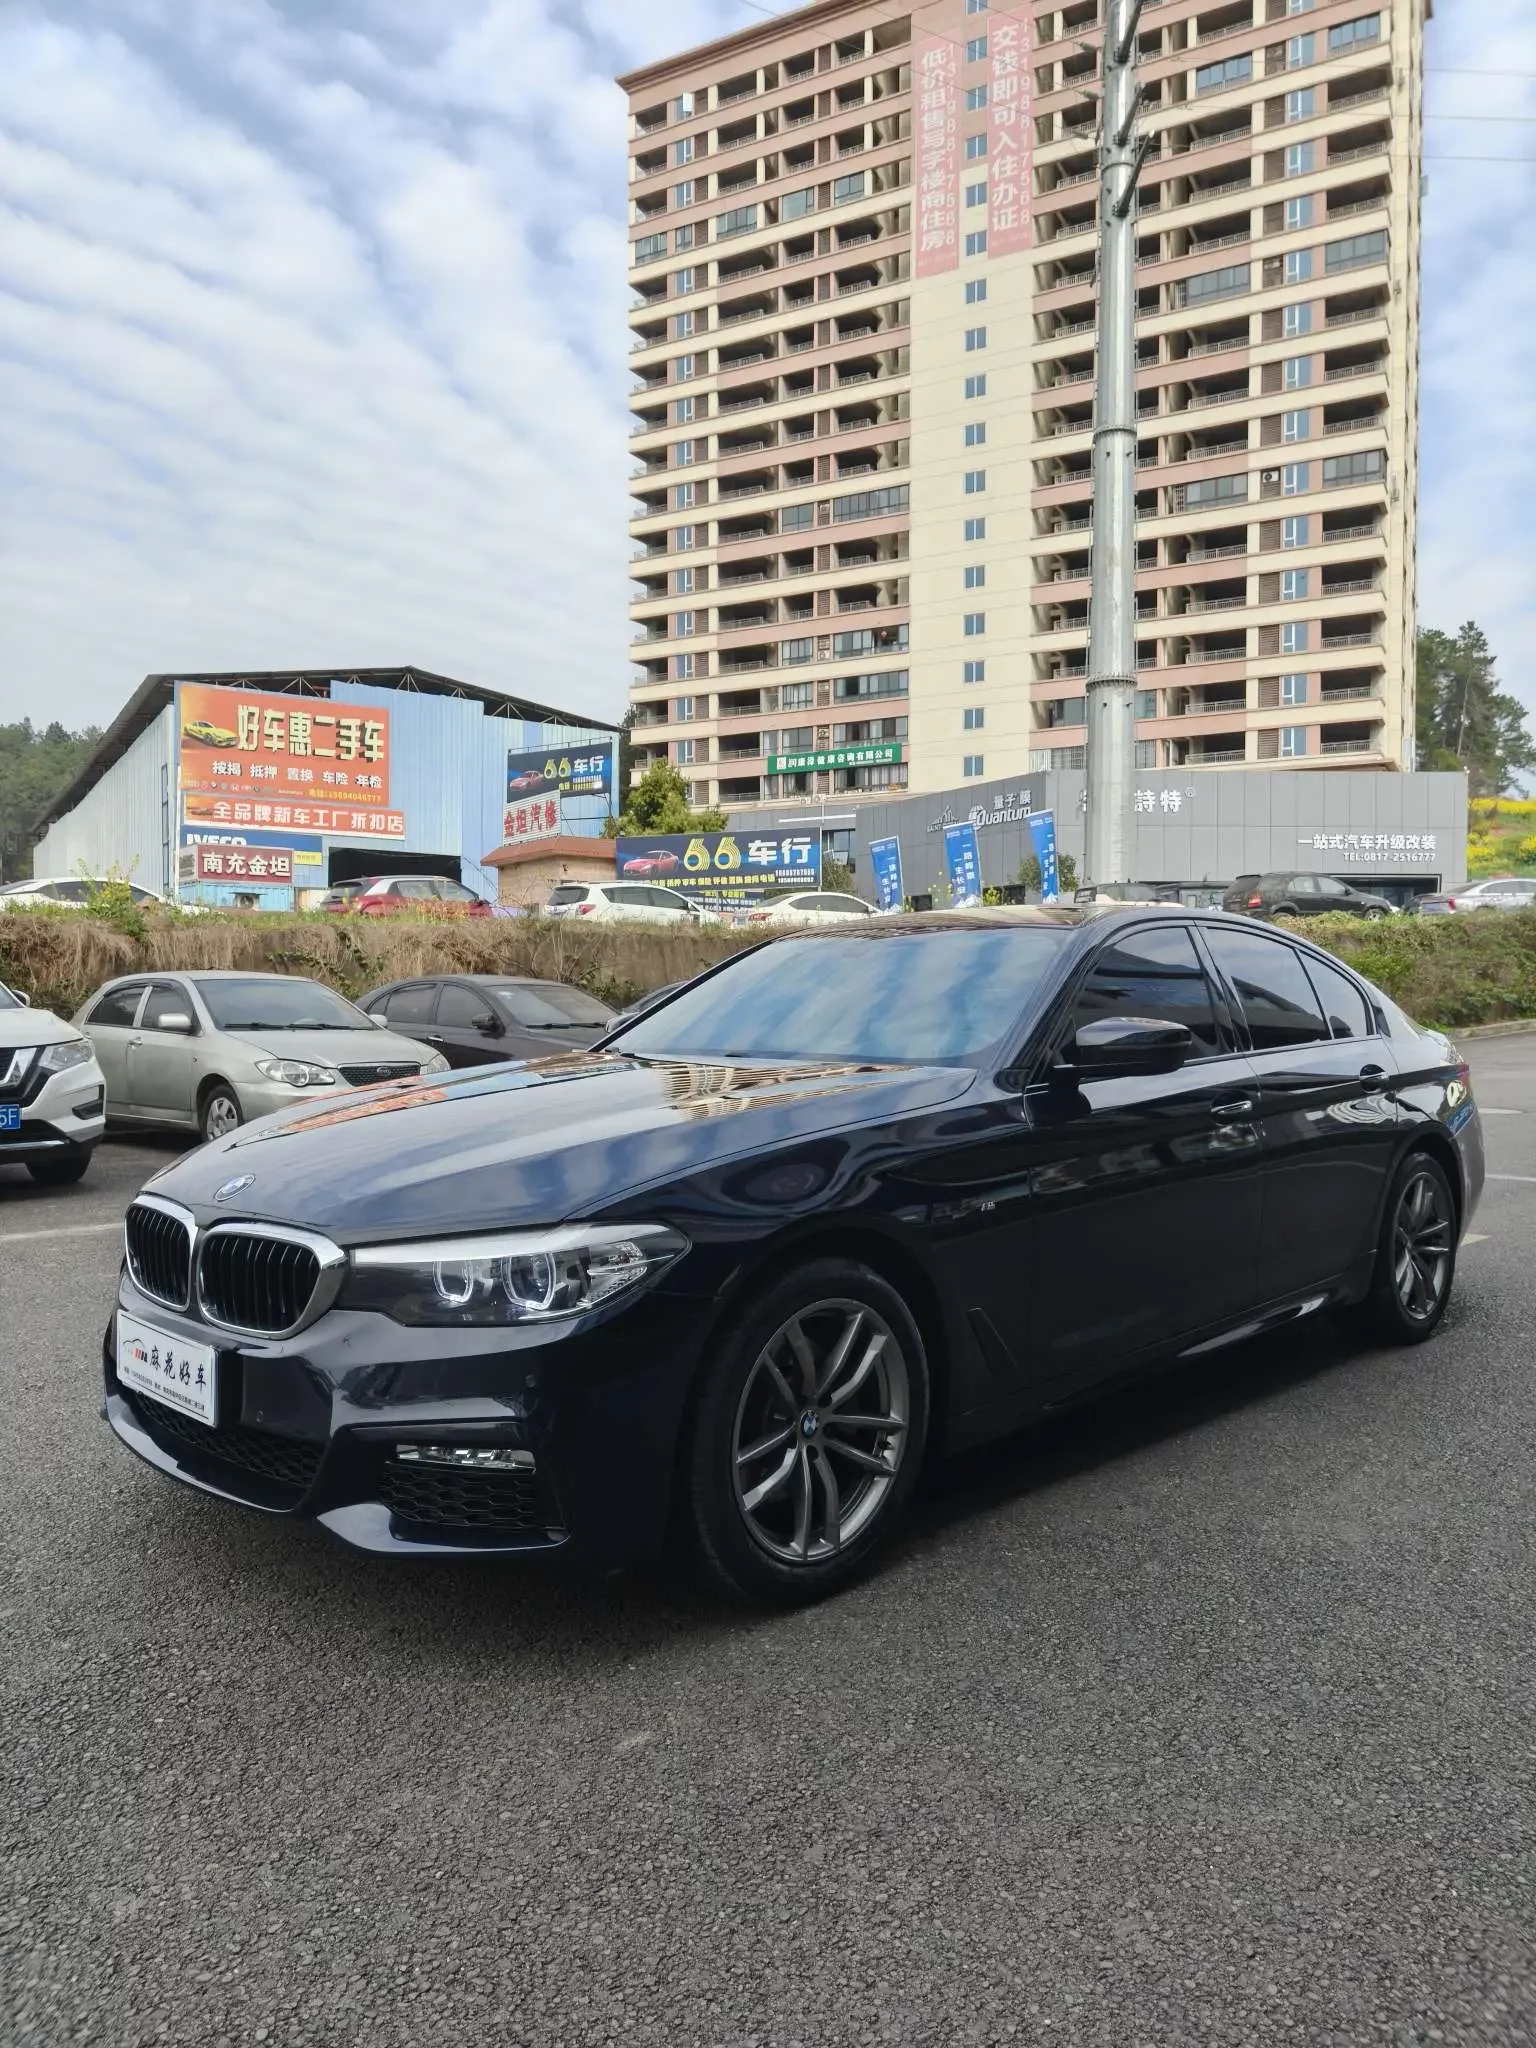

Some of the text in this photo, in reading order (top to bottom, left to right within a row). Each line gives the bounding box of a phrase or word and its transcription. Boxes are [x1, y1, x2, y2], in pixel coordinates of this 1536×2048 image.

[237, 704, 385, 762] 好车惠二手车
[212, 760, 383, 789] 按揭 抵押 置换 车险 年检
[994, 790, 1032, 810] 量子膜
[213, 802, 404, 832] 全品牌新车工厂折扣店
[1297, 833, 1437, 850] 一站式汽车升级改装
[202, 852, 291, 878] 南充金坦
